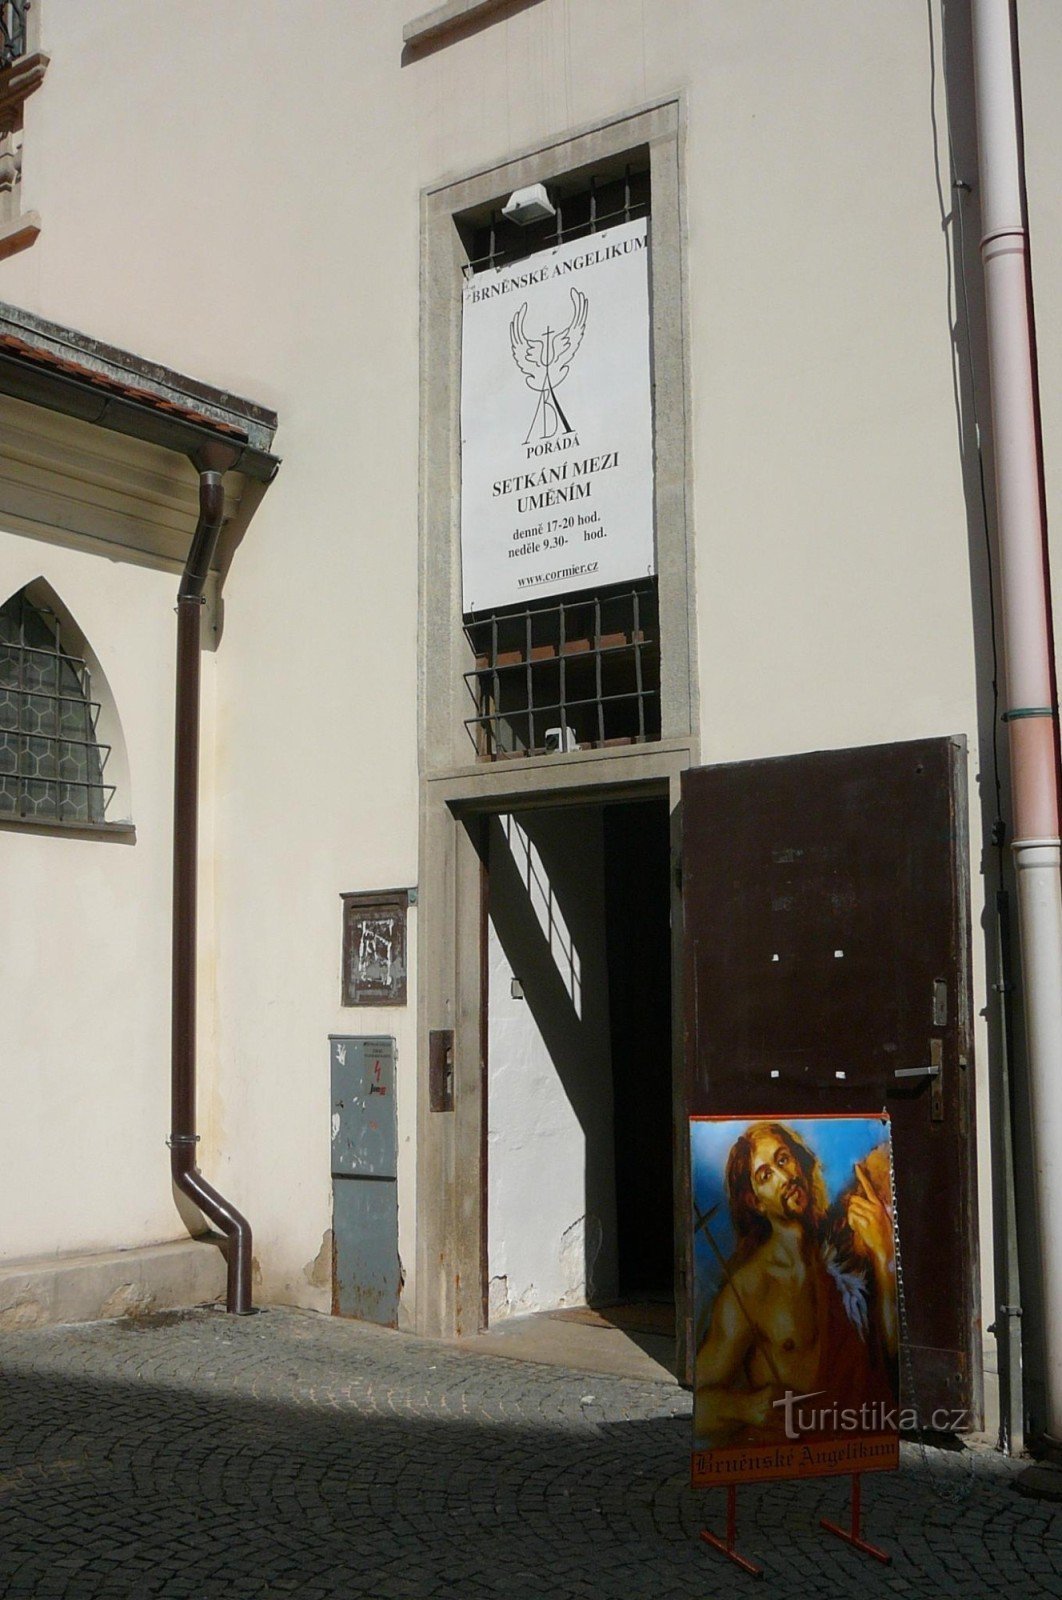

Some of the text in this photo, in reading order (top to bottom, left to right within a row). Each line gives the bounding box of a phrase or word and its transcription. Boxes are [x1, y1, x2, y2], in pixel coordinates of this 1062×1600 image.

[472, 234, 648, 303] BRNĚNSKÉ ANGELIKUM
[492, 451, 620, 497] SETKÁNÍ MEZI
[517, 481, 593, 514] UMĚNÍM
[512, 510, 601, 541] denně 17-20 hod.
[508, 541, 541, 559] neděle
[583, 526, 607, 542] hod.
[517, 560, 599, 588] www.cormier.cz
[799, 1441, 897, 1467] Angelikum
